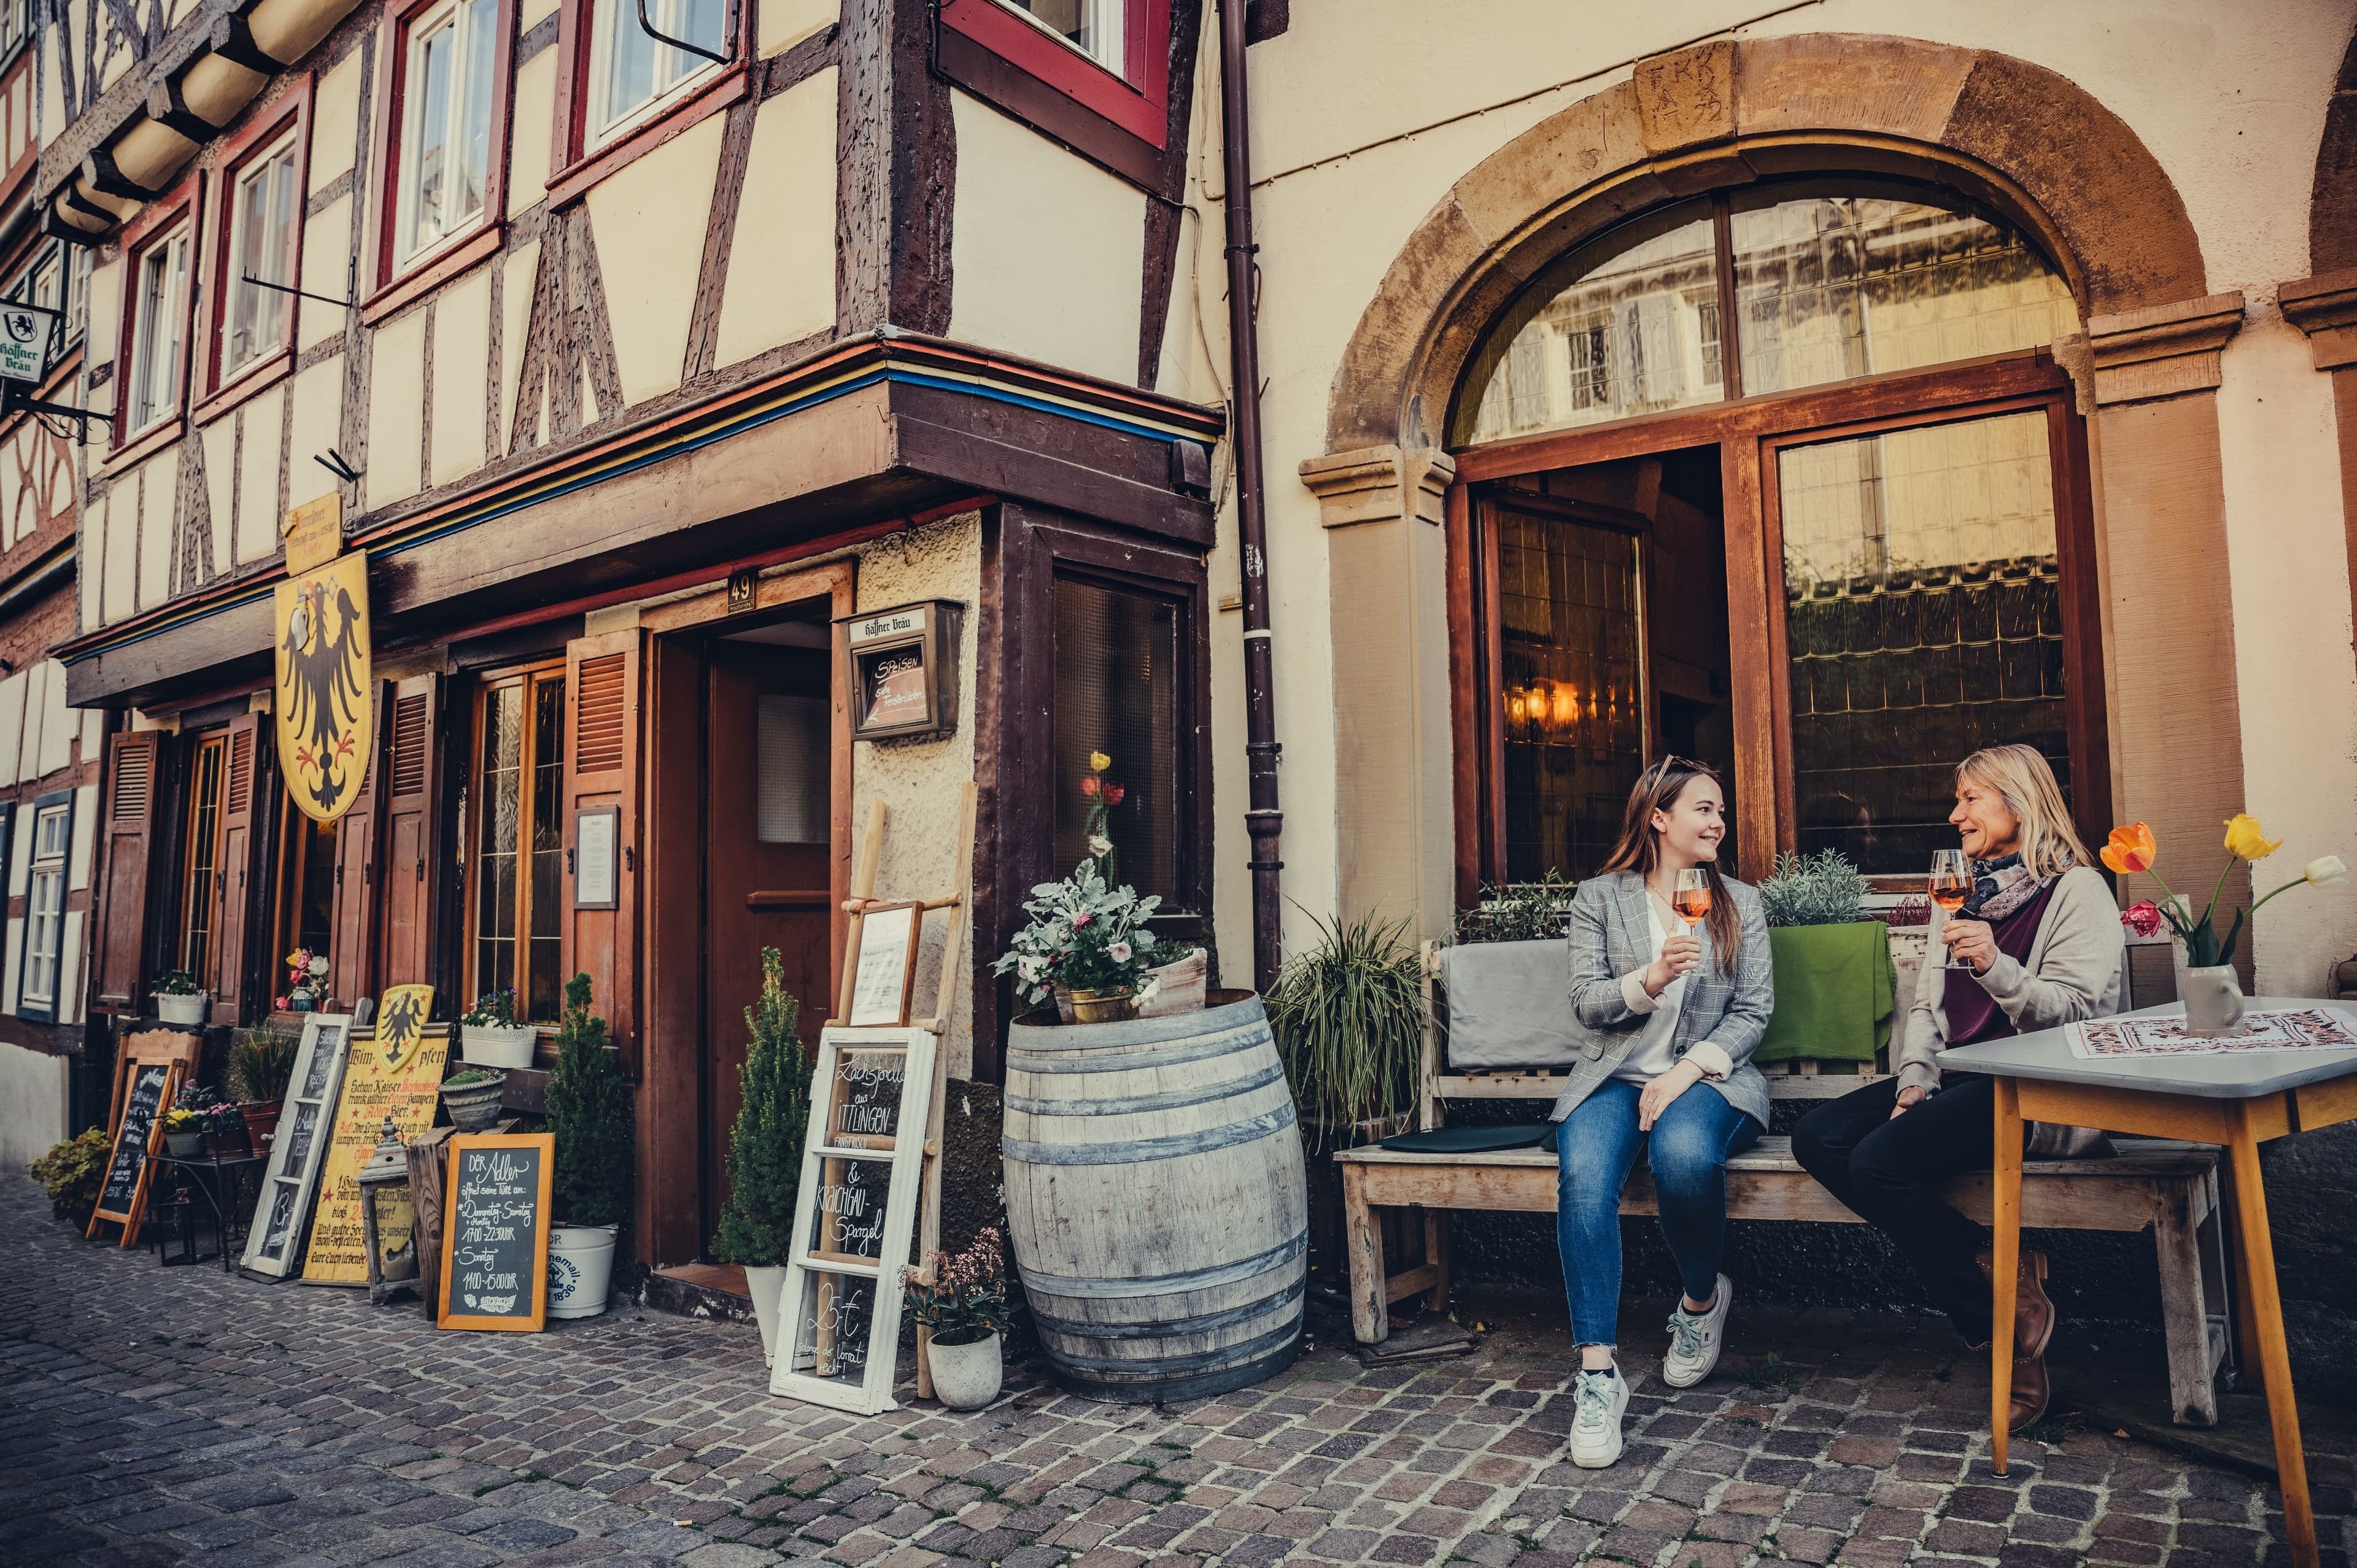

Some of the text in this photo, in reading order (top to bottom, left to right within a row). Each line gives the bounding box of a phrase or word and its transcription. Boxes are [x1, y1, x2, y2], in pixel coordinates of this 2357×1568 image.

[732, 575, 749, 601] 49
[892, 617, 911, 630] Bräu
[419, 1047, 445, 1068] pfen
[373, 1079, 401, 1094] Kaiser
[855, 1094, 869, 1104] aus
[834, 1136, 867, 1149] FANGFRISCH
[476, 1151, 530, 1184] Adler
[848, 1162, 860, 1184] &
[462, 1182, 480, 1200] öffnet
[481, 1186, 497, 1195] seine
[471, 1216, 491, 1228] Montag
[829, 1208, 883, 1256] Spargel
[459, 1246, 499, 1271] Sonntag
[554, 1284, 576, 1302] 1836
[822, 1340, 834, 1356] der
